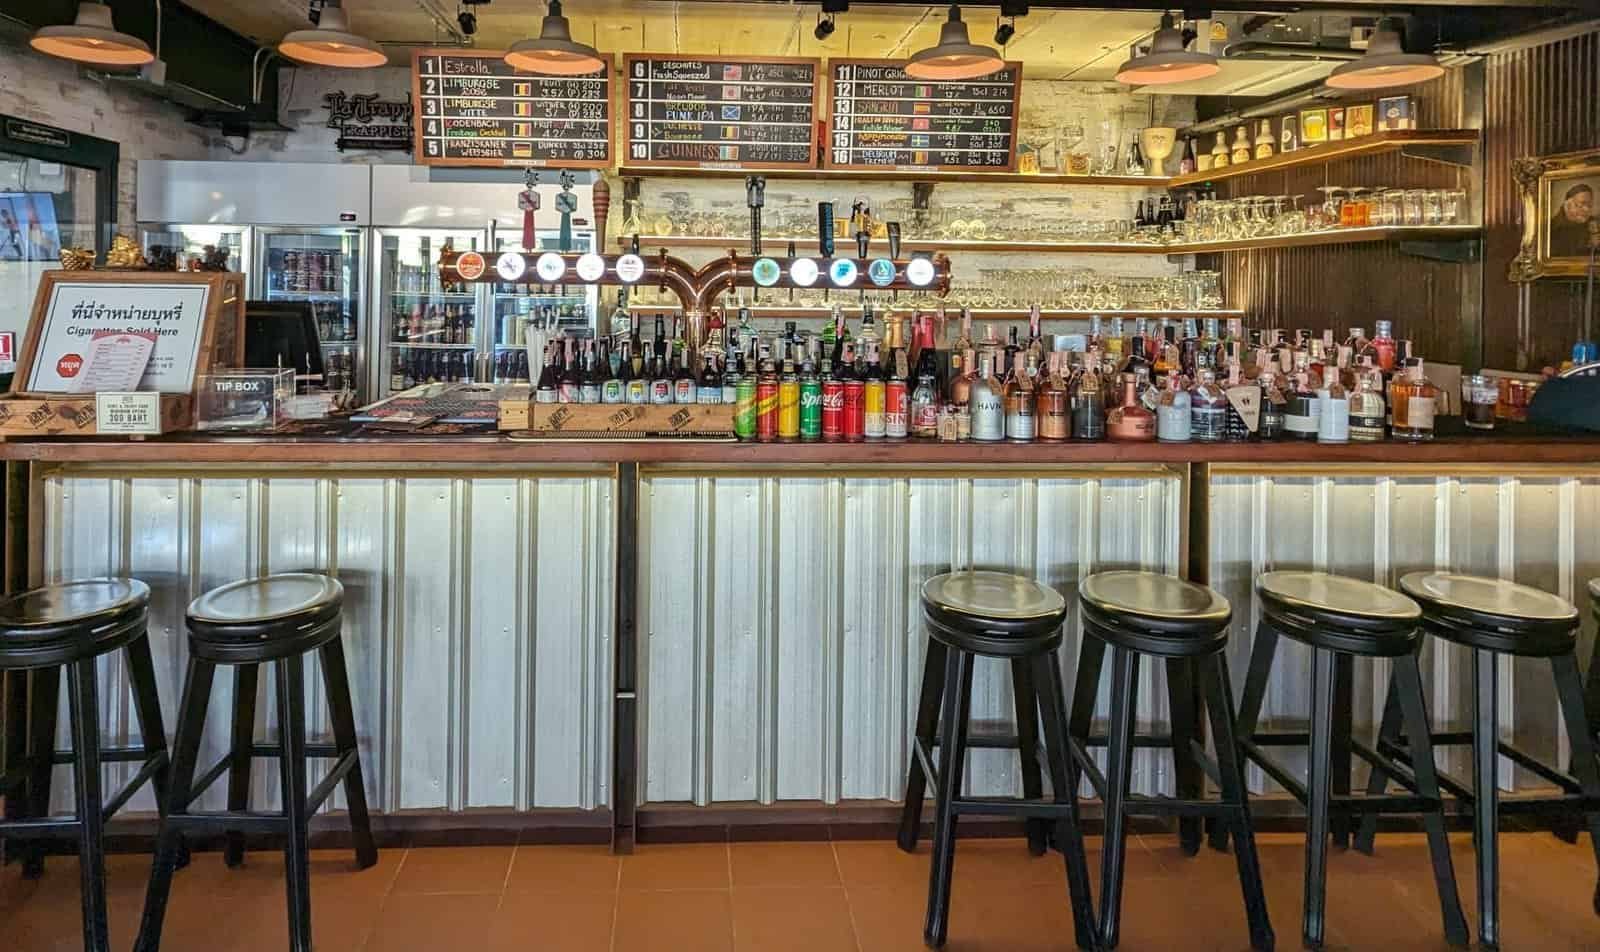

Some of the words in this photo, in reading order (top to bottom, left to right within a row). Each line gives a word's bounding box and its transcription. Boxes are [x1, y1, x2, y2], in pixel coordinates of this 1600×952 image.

[425, 59, 433, 74] 1
[635, 62, 644, 77] 6
[838, 65, 851, 80] 11
[857, 67, 882, 79] PINOT
[884, 68, 912, 80] GRIG
[426, 79, 435, 94] 2
[582, 80, 601, 90] 200
[636, 83, 644, 97] 7
[836, 83, 851, 97] 12
[863, 84, 905, 97] MERLOT
[353, 93, 414, 123] Trapp
[427, 99, 436, 114] 3
[635, 102, 644, 118] 8
[836, 100, 850, 114] 13
[697, 111, 715, 121] IPA
[835, 116, 849, 130] 14
[427, 120, 436, 134] 4
[635, 123, 644, 138] 9
[428, 140, 437, 155] 5
[834, 133, 848, 148] 15
[632, 143, 647, 158] 10
[655, 143, 720, 160] GUINNESS
[833, 150, 848, 164] 16
[71, 300, 183, 326] ที่นี่จำหน่ายบุหรี่
[153, 327, 178, 336] Here
[215, 382, 232, 391] TIP
[235, 382, 259, 391] BOX
[127, 414, 148, 422] BAHT
